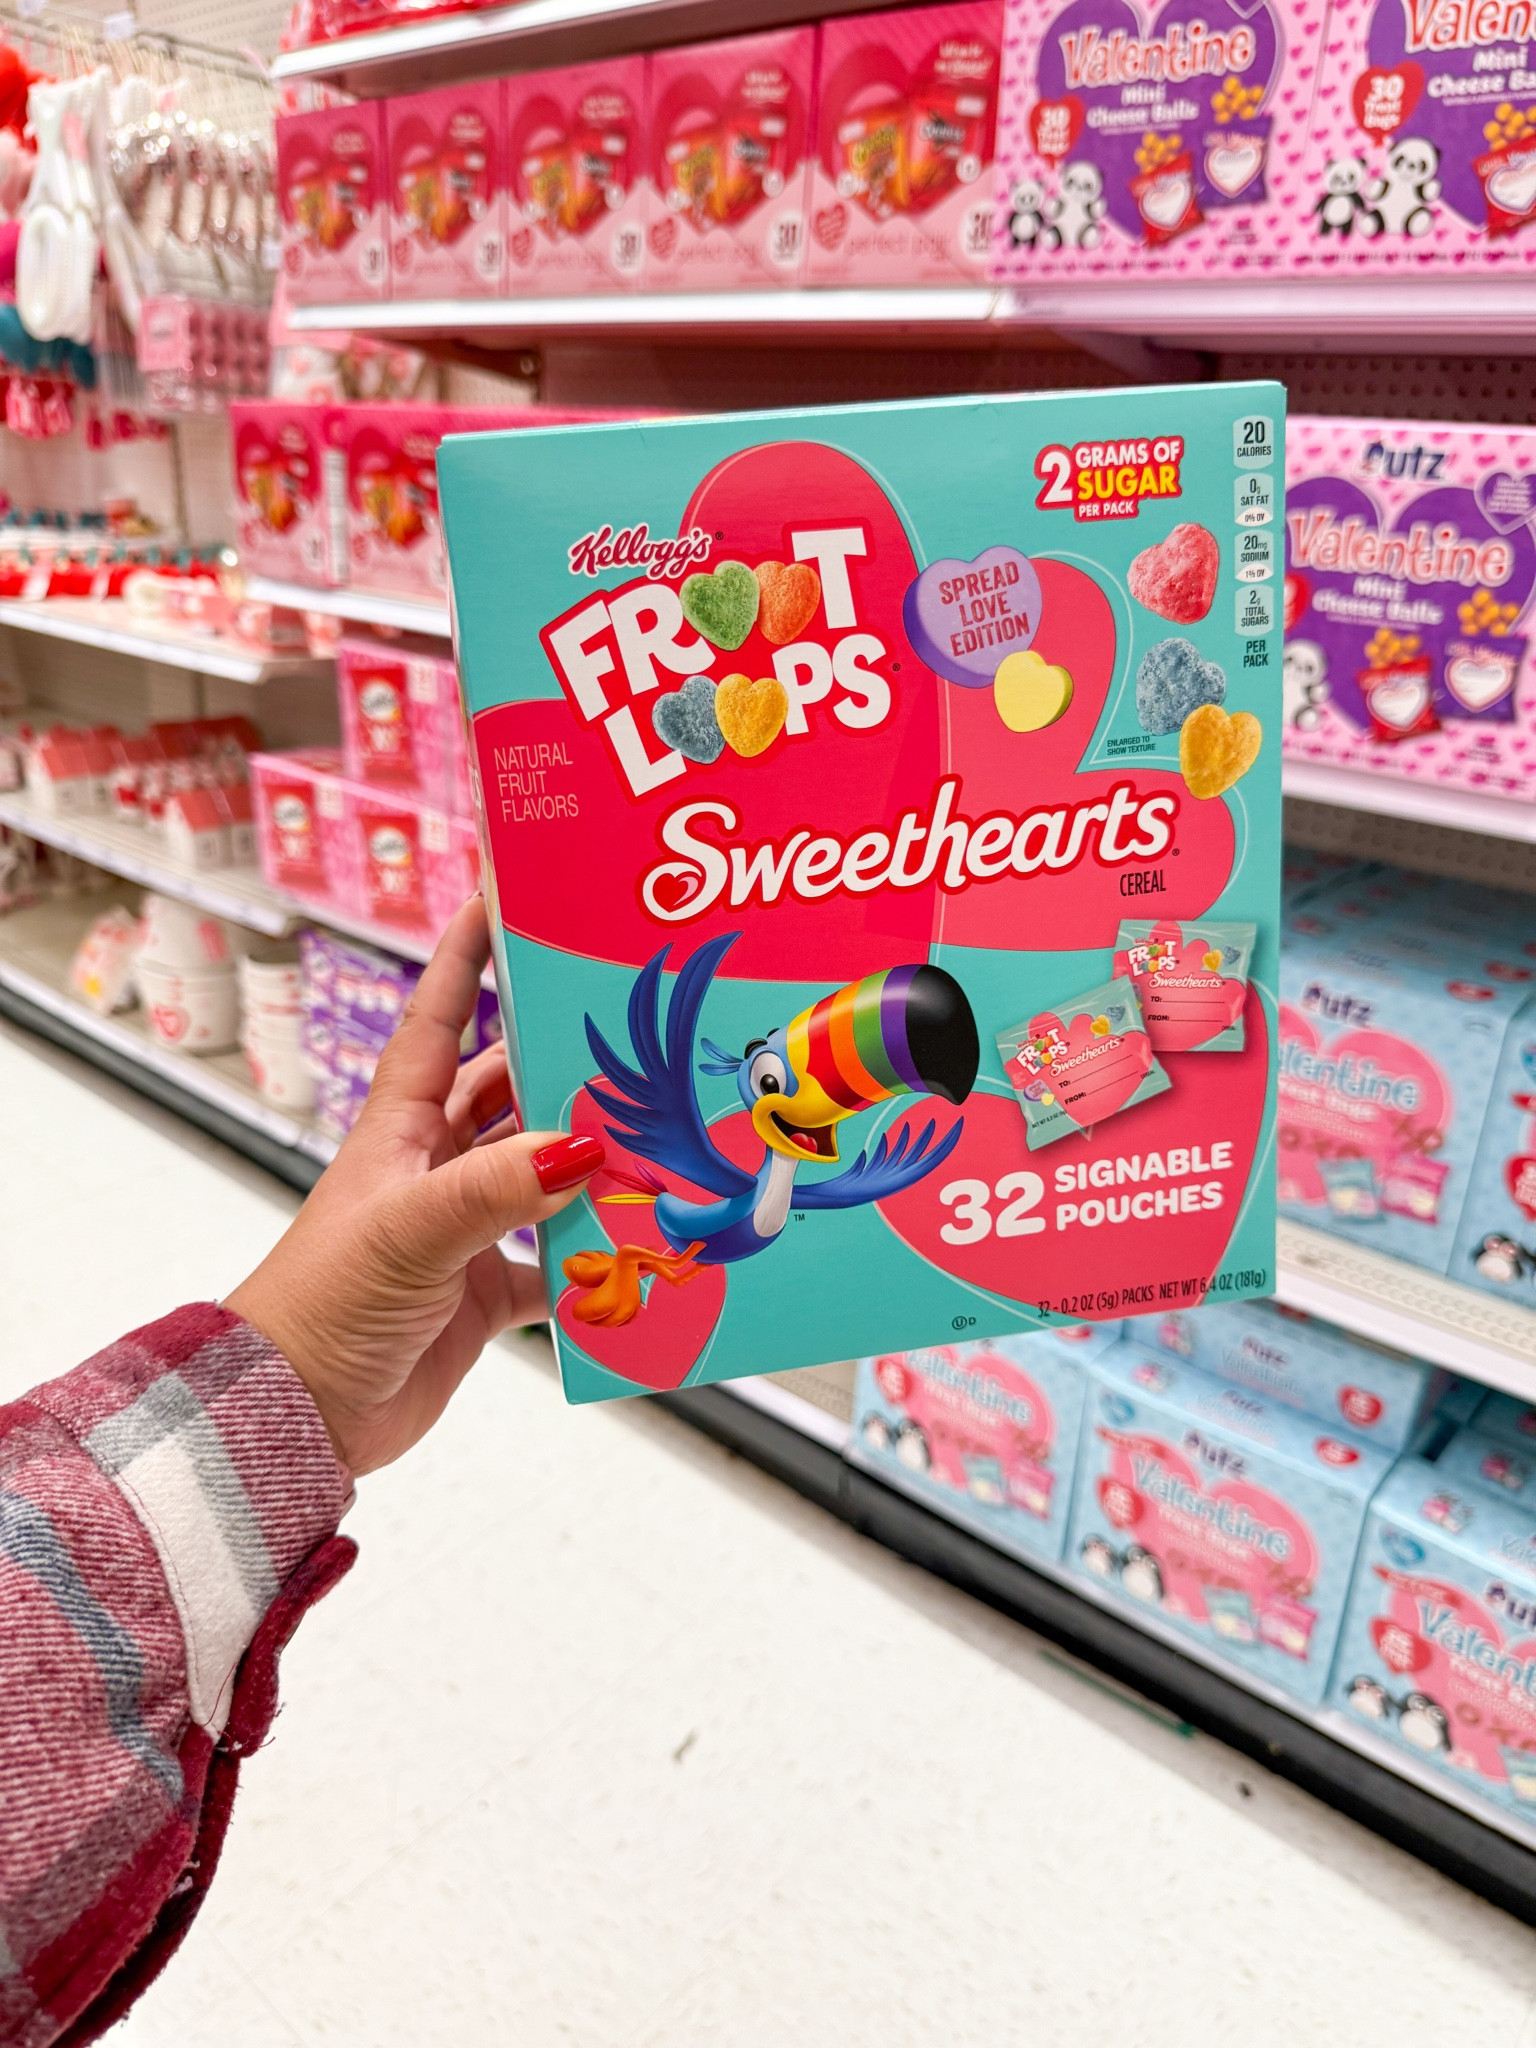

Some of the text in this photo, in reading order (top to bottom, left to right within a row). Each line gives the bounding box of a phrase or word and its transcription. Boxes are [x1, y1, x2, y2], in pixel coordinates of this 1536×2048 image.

[1404, 0, 1536, 54] Valen
[1059, 19, 1257, 89] Valentine
[1473, 47, 1529, 72] Mini
[1369, 75, 1404, 99] 30
[1427, 74, 1506, 98] Cheese
[1243, 421, 1265, 444] 20
[1237, 445, 1272, 457] CALORIES
[1041, 441, 1181, 504] 2 GRAMS OF
[1077, 465, 1178, 500] SUGAR
[1078, 501, 1134, 518] PER PACK
[1240, 495, 1269, 506] SAT FAT
[568, 523, 712, 580] Kellogg's
[1240, 551, 1269, 562] SODIUM
[1287, 505, 1516, 587] Valentine
[938, 561, 1020, 605] SPREAD
[959, 591, 1012, 627] LOVE
[1241, 615, 1269, 627] SUGARS
[1244, 606, 1266, 616] TOTAL
[549, 527, 869, 722] FRT
[950, 612, 1030, 657] EDITION
[1243, 653, 1269, 668] PACK
[1246, 639, 1266, 654] PER
[603, 633, 893, 798] LPS
[1107, 735, 1151, 748] ENLARGED TO
[1107, 743, 1156, 756] SHOW TEXTURE
[493, 742, 574, 771] NATURAL
[497, 770, 547, 797] FRUIT
[501, 793, 579, 823] FLAVORS
[642, 780, 1174, 922] Sweethearts
[1119, 869, 1167, 897] CEREAL
[1128, 941, 1177, 965] FRT
[1132, 956, 1176, 977] LPS
[1149, 971, 1222, 989] Sweethearts
[1147, 1014, 1171, 1022] FROM:
[1016, 1028, 1060, 1068] FRT
[1027, 1041, 1069, 1076] LPS
[1050, 1037, 1122, 1077] Sweethearts
[1058, 1079, 1072, 1089] TO:
[1064, 1091, 1088, 1106] FROM:
[1054, 1141, 1234, 1194] SIGNABLE
[939, 1170, 1047, 1246] 32
[1055, 1181, 1224, 1231] POUCHES
[1038, 1301, 1050, 1318] 32
[1061, 1296, 1078, 1314] 0.2
[1080, 1294, 1094, 1311] OZ
[1097, 1290, 1119, 1310] (5g)
[1121, 1285, 1154, 1304] PACKS
[1159, 1281, 1179, 1300] NET
[1180, 1278, 1197, 1297] WT
[1199, 1276, 1216, 1293] 6.4
[1219, 1274, 1232, 1290] OZ
[1235, 1269, 1266, 1291] (181g)
